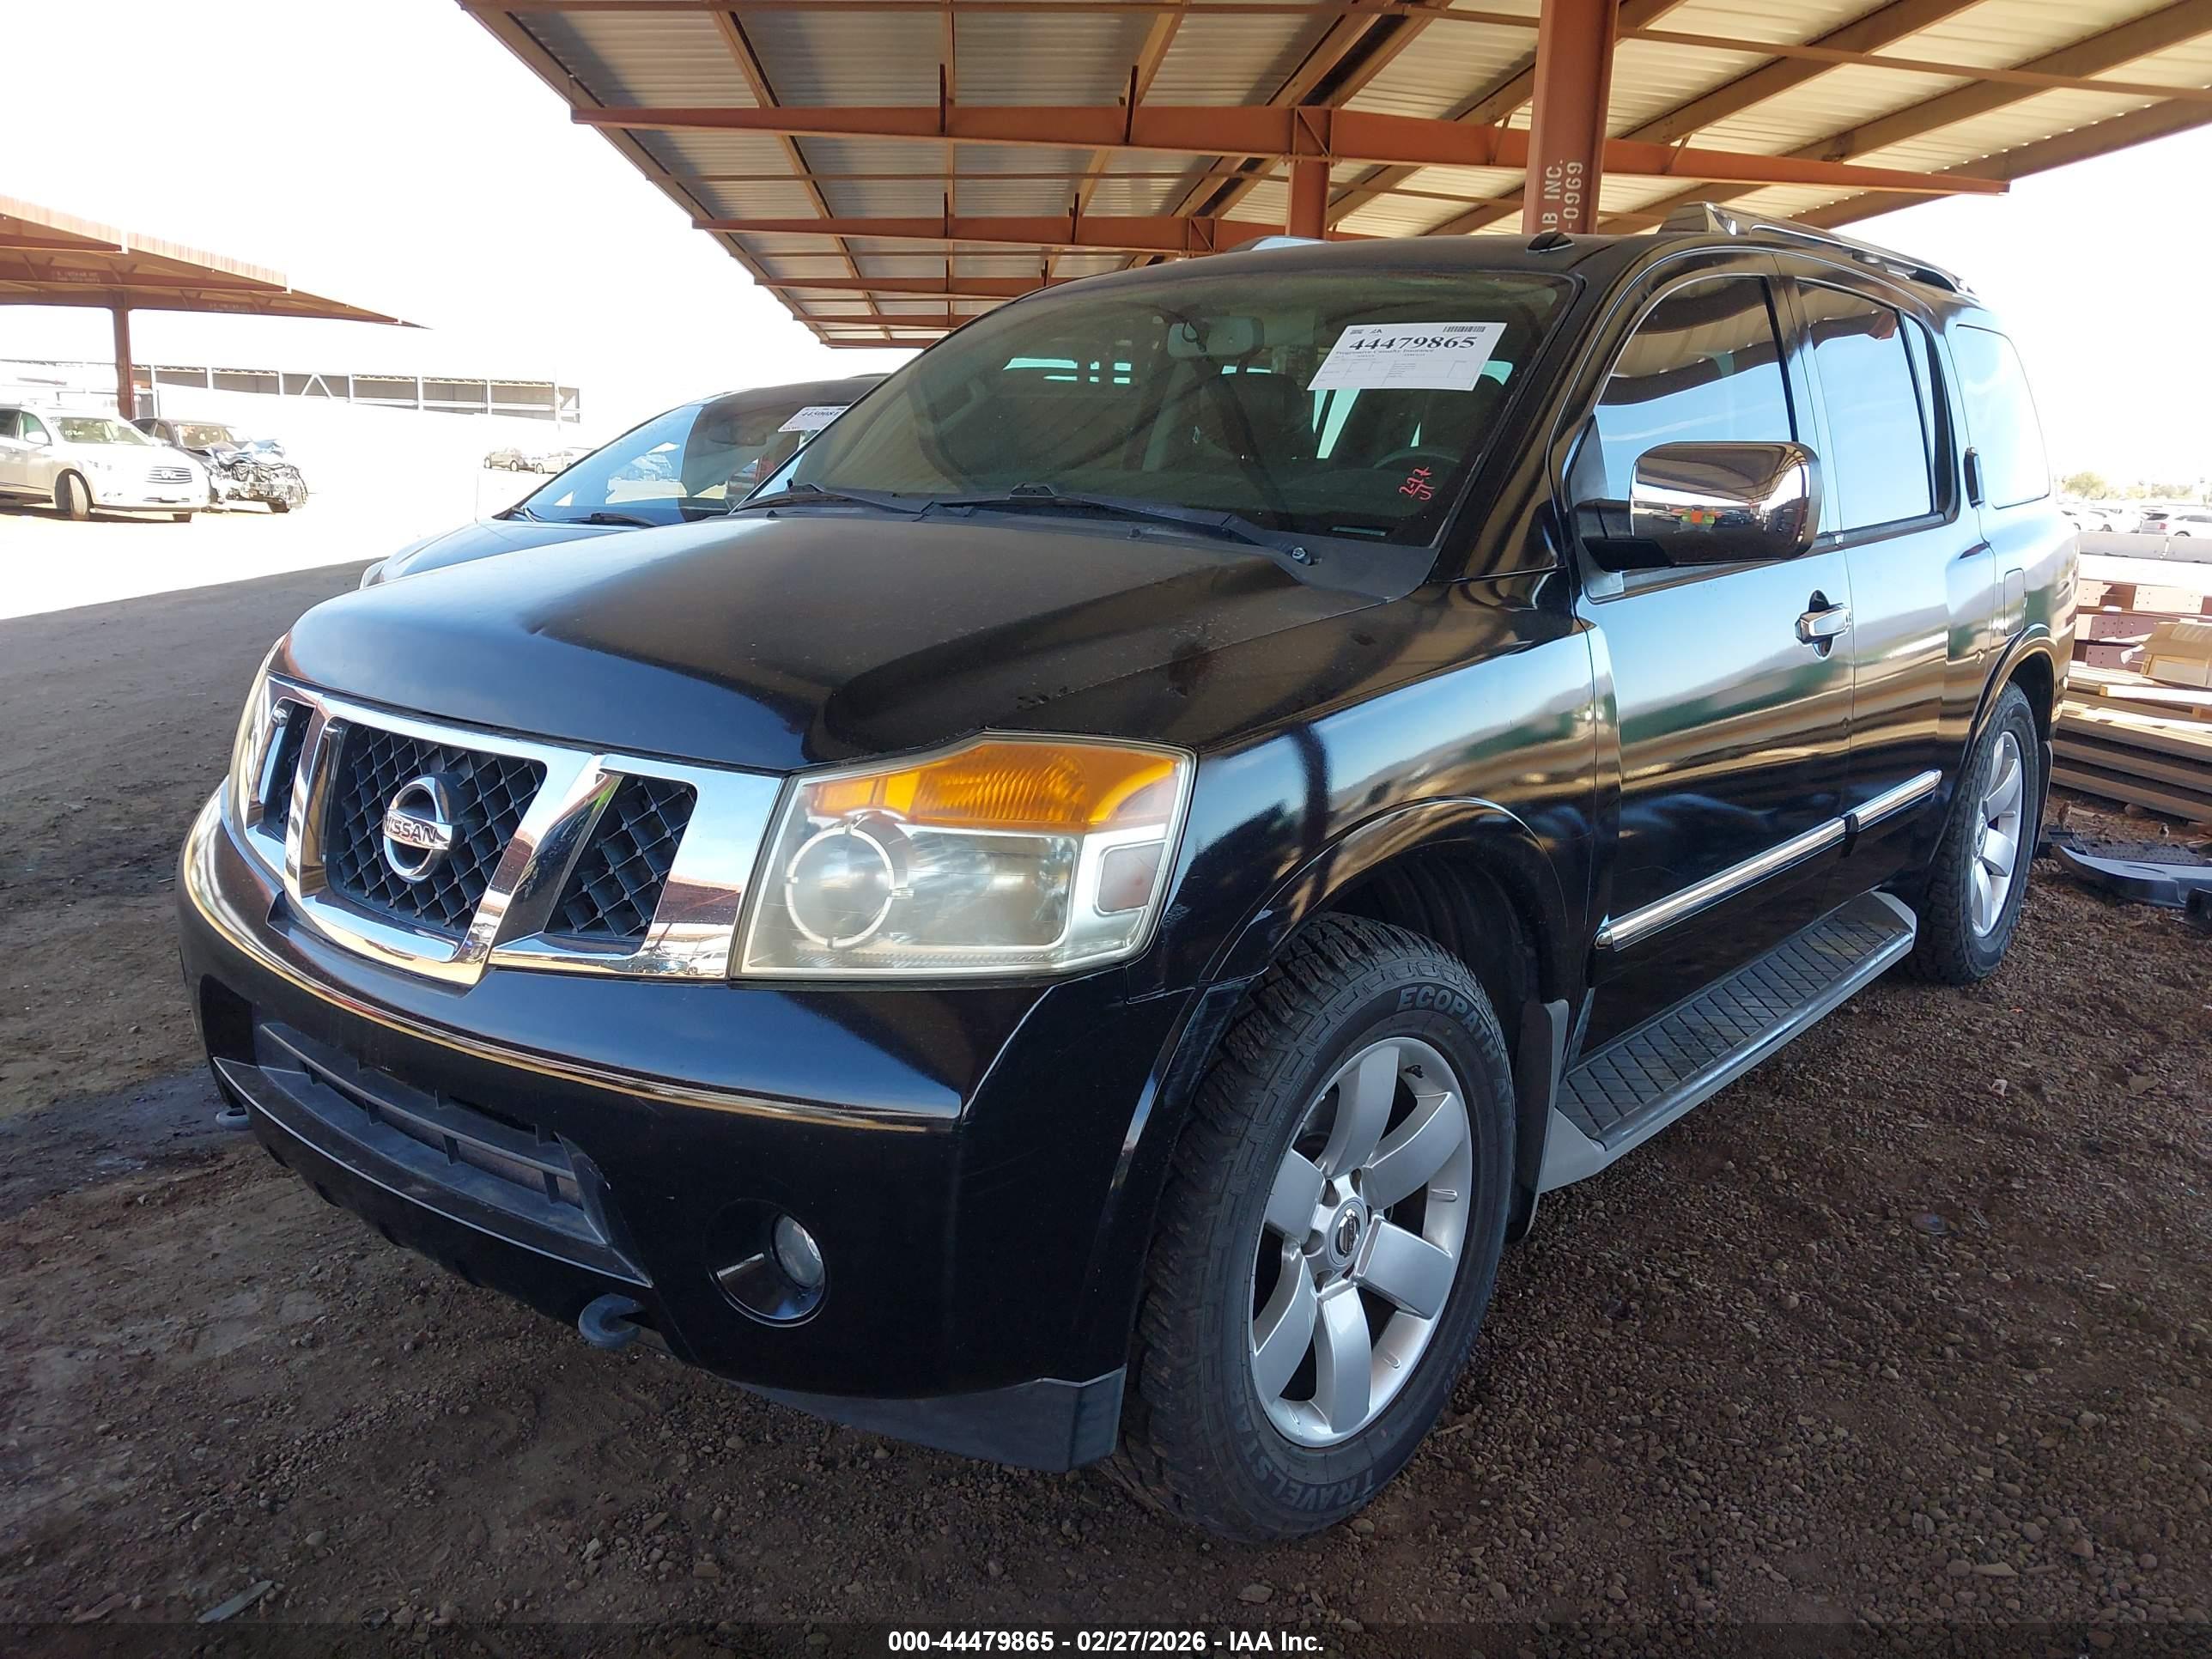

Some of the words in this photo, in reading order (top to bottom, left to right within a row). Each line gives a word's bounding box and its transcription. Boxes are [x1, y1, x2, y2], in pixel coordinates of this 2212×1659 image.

[1544, 159, 1563, 199] INC.
[1562, 161, 1583, 234] -0969
[1349, 335, 1478, 350] 44479865
[383, 817, 437, 843] NISSAN
